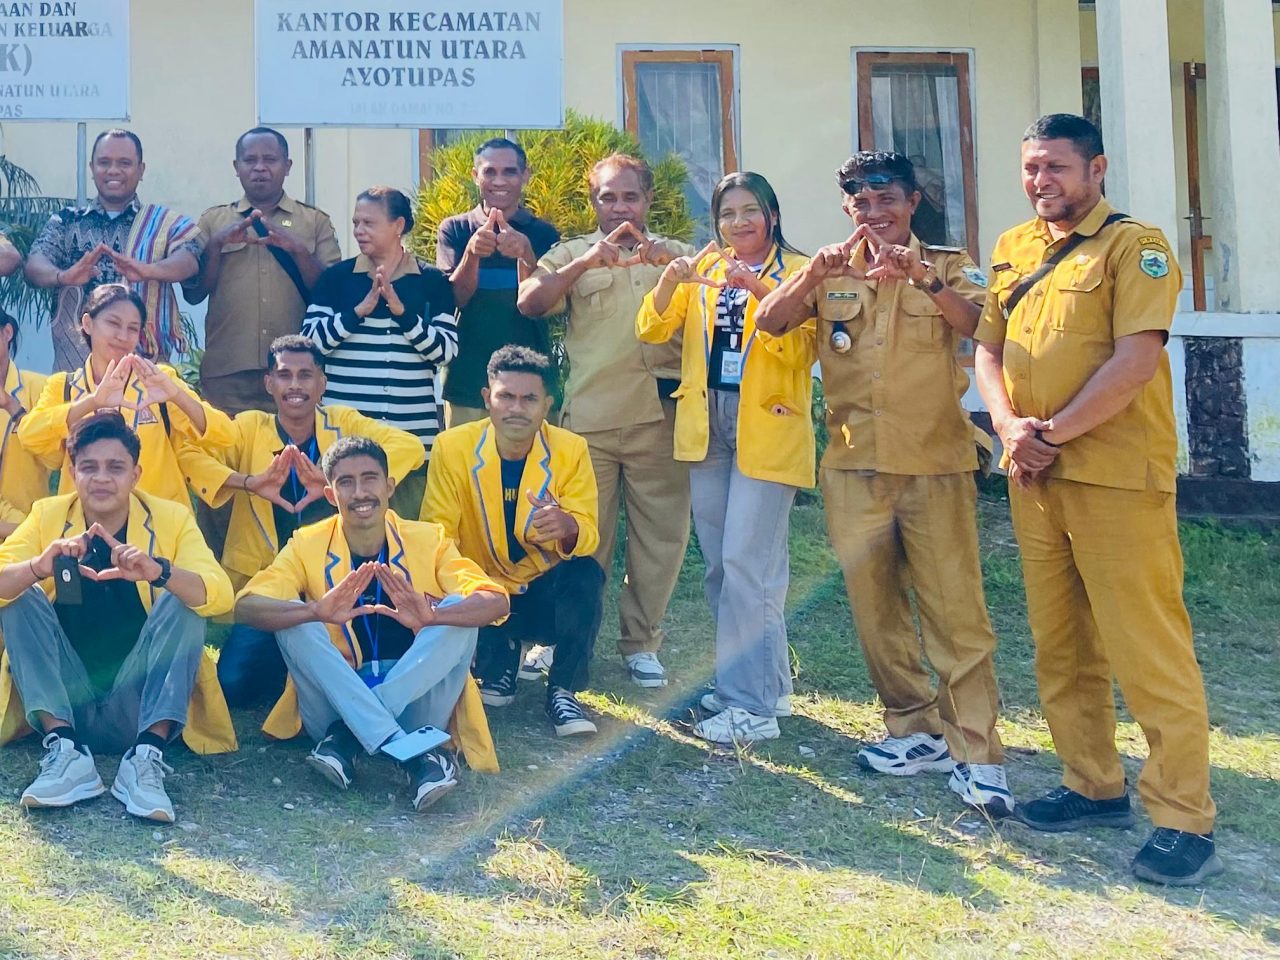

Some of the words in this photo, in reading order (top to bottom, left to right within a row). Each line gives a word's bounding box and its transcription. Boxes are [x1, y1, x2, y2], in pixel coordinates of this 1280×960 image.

[39, 1, 77, 17] DAN
[13, 21, 113, 38] KELUARGA
[276, 11, 381, 33] KANTOR
[388, 11, 542, 33] KECAMATAN
[291, 39, 432, 60] AMANATUN
[440, 39, 527, 60] UTARA
[340, 67, 476, 87] AYOTUPAS
[50, 84, 101, 97] UTARA
